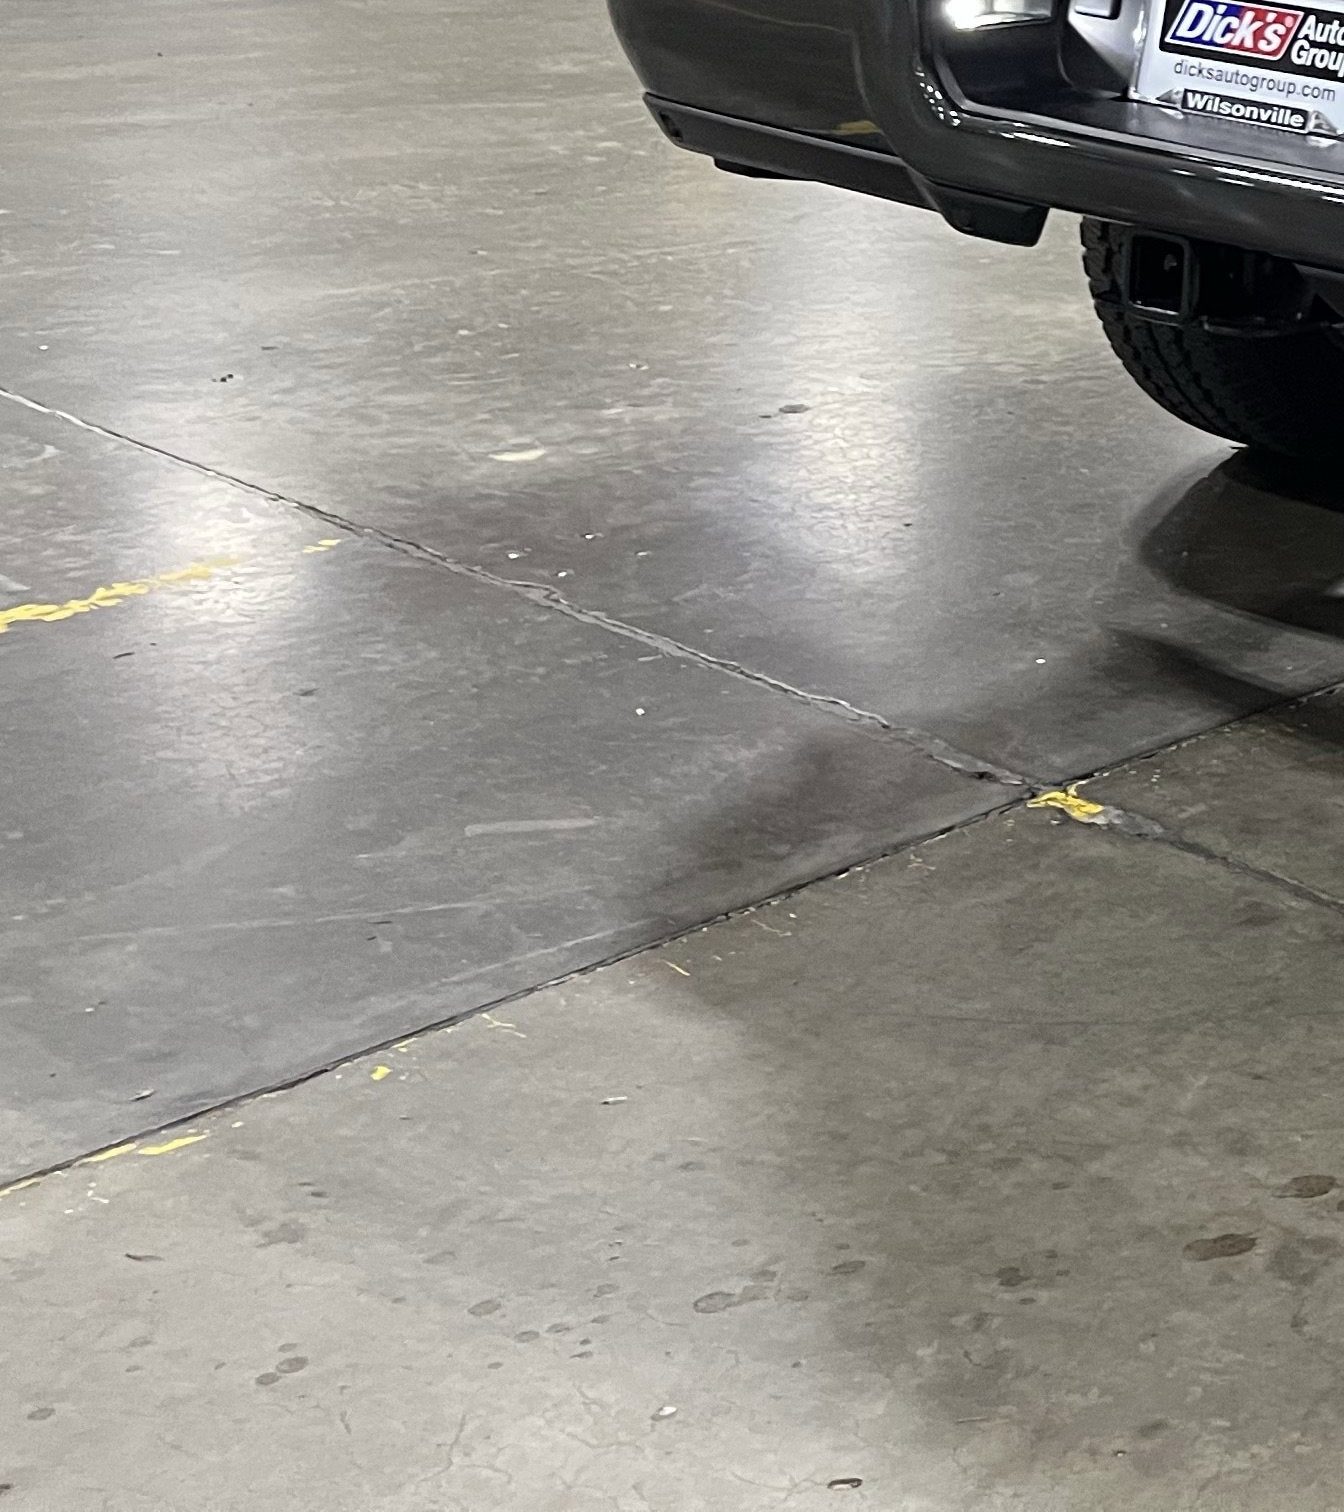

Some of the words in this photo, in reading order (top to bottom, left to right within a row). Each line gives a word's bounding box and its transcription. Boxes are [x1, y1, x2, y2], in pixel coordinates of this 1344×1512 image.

[1174, 1, 1288, 52] Dick's
[1173, 59, 1337, 102] dicksautogroup.com
[1186, 91, 1305, 128] Wilsonville
